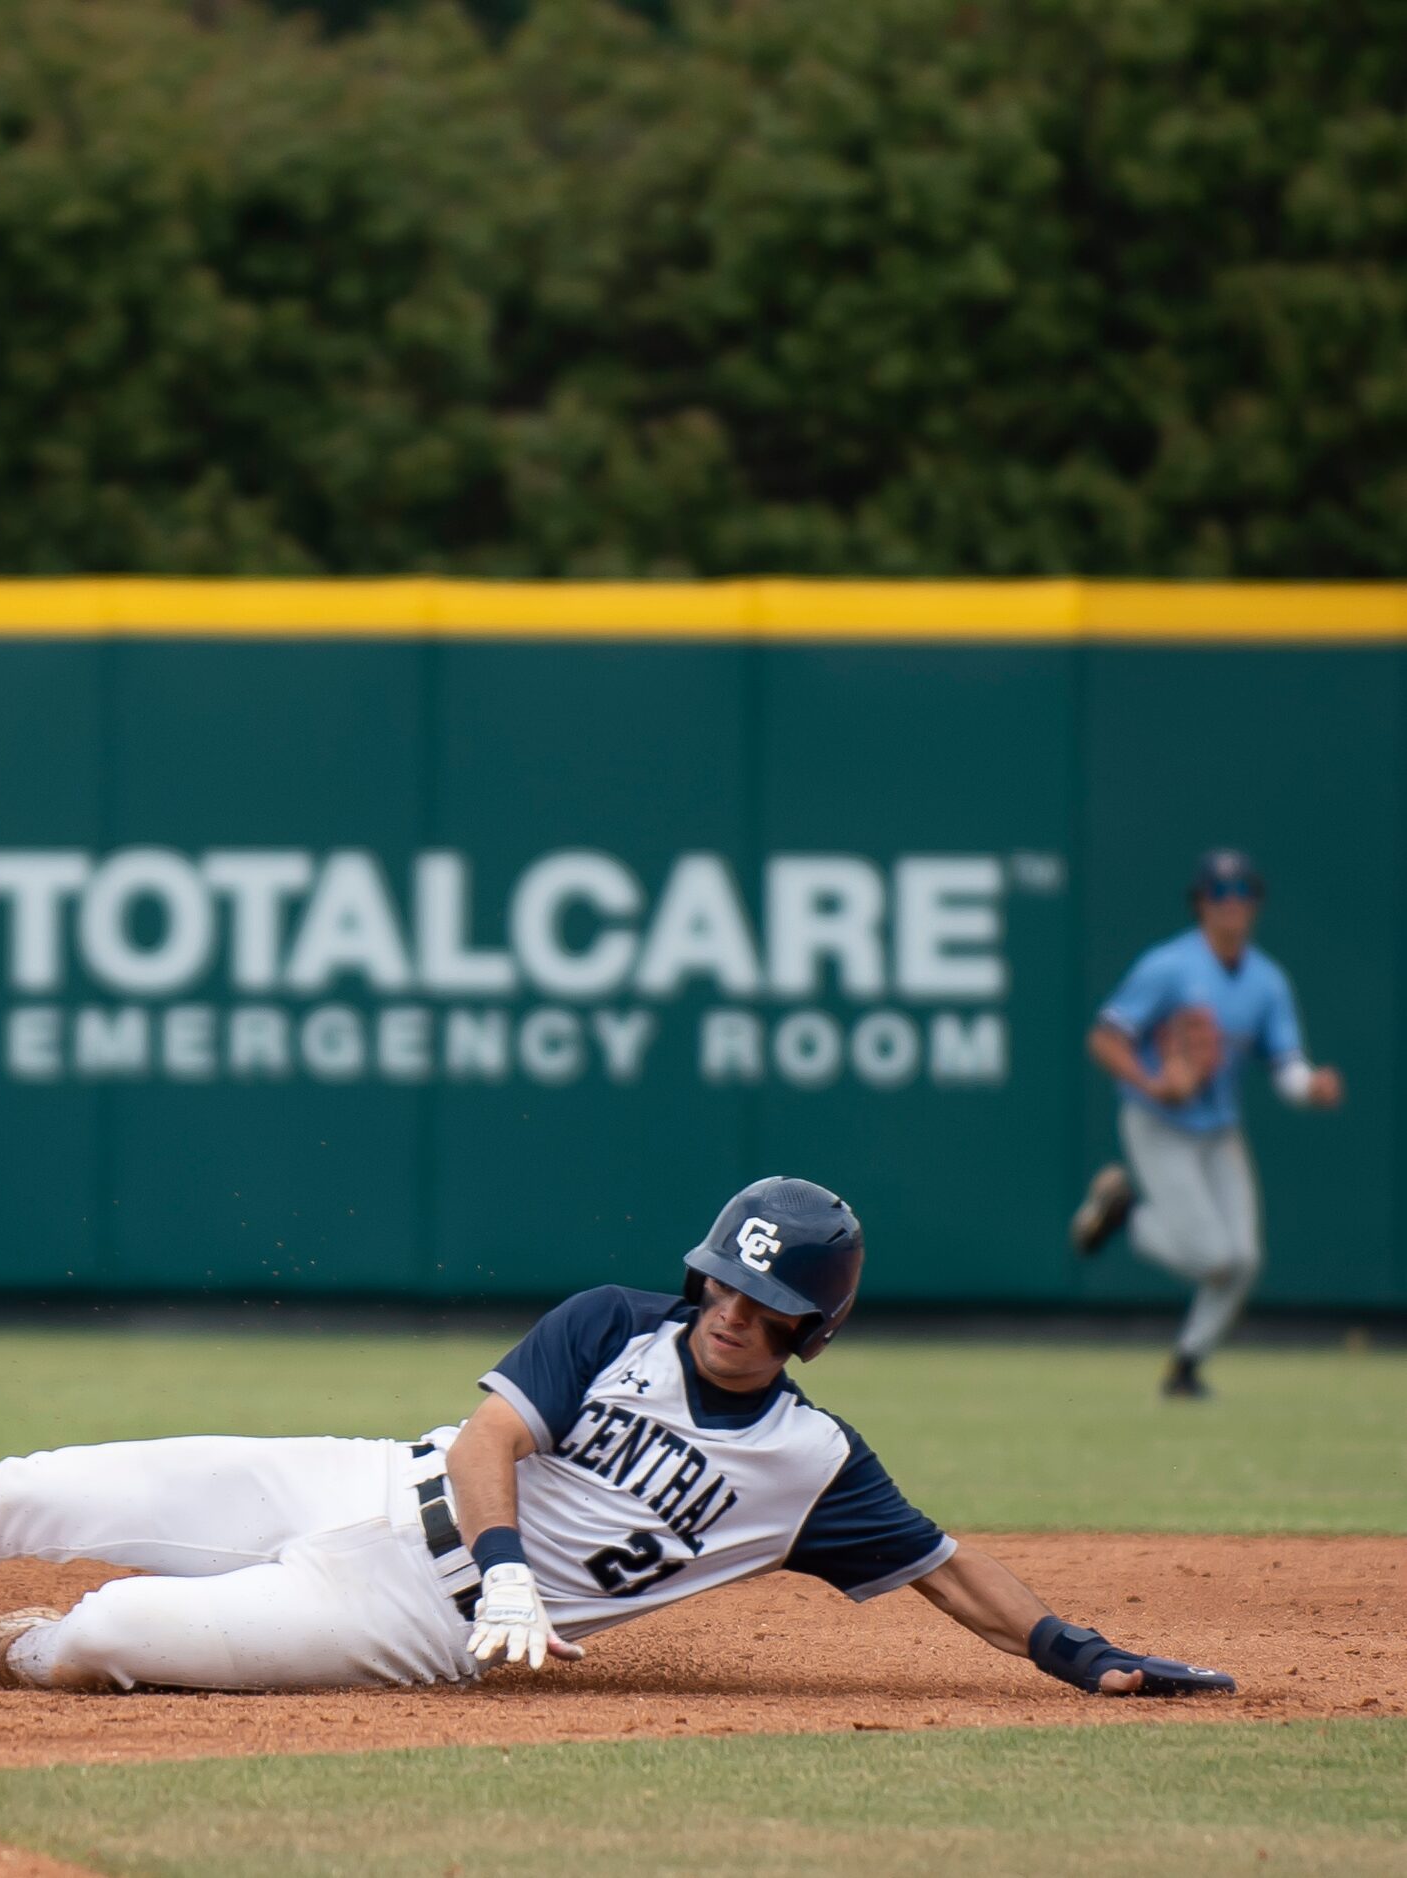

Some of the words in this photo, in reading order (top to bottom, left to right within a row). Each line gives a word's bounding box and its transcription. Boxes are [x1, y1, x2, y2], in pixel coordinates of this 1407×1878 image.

[7, 1006, 649, 1082] EMERGENCY
[701, 1010, 1004, 1086] ROOM
[553, 1400, 739, 1557] CENTRAL
